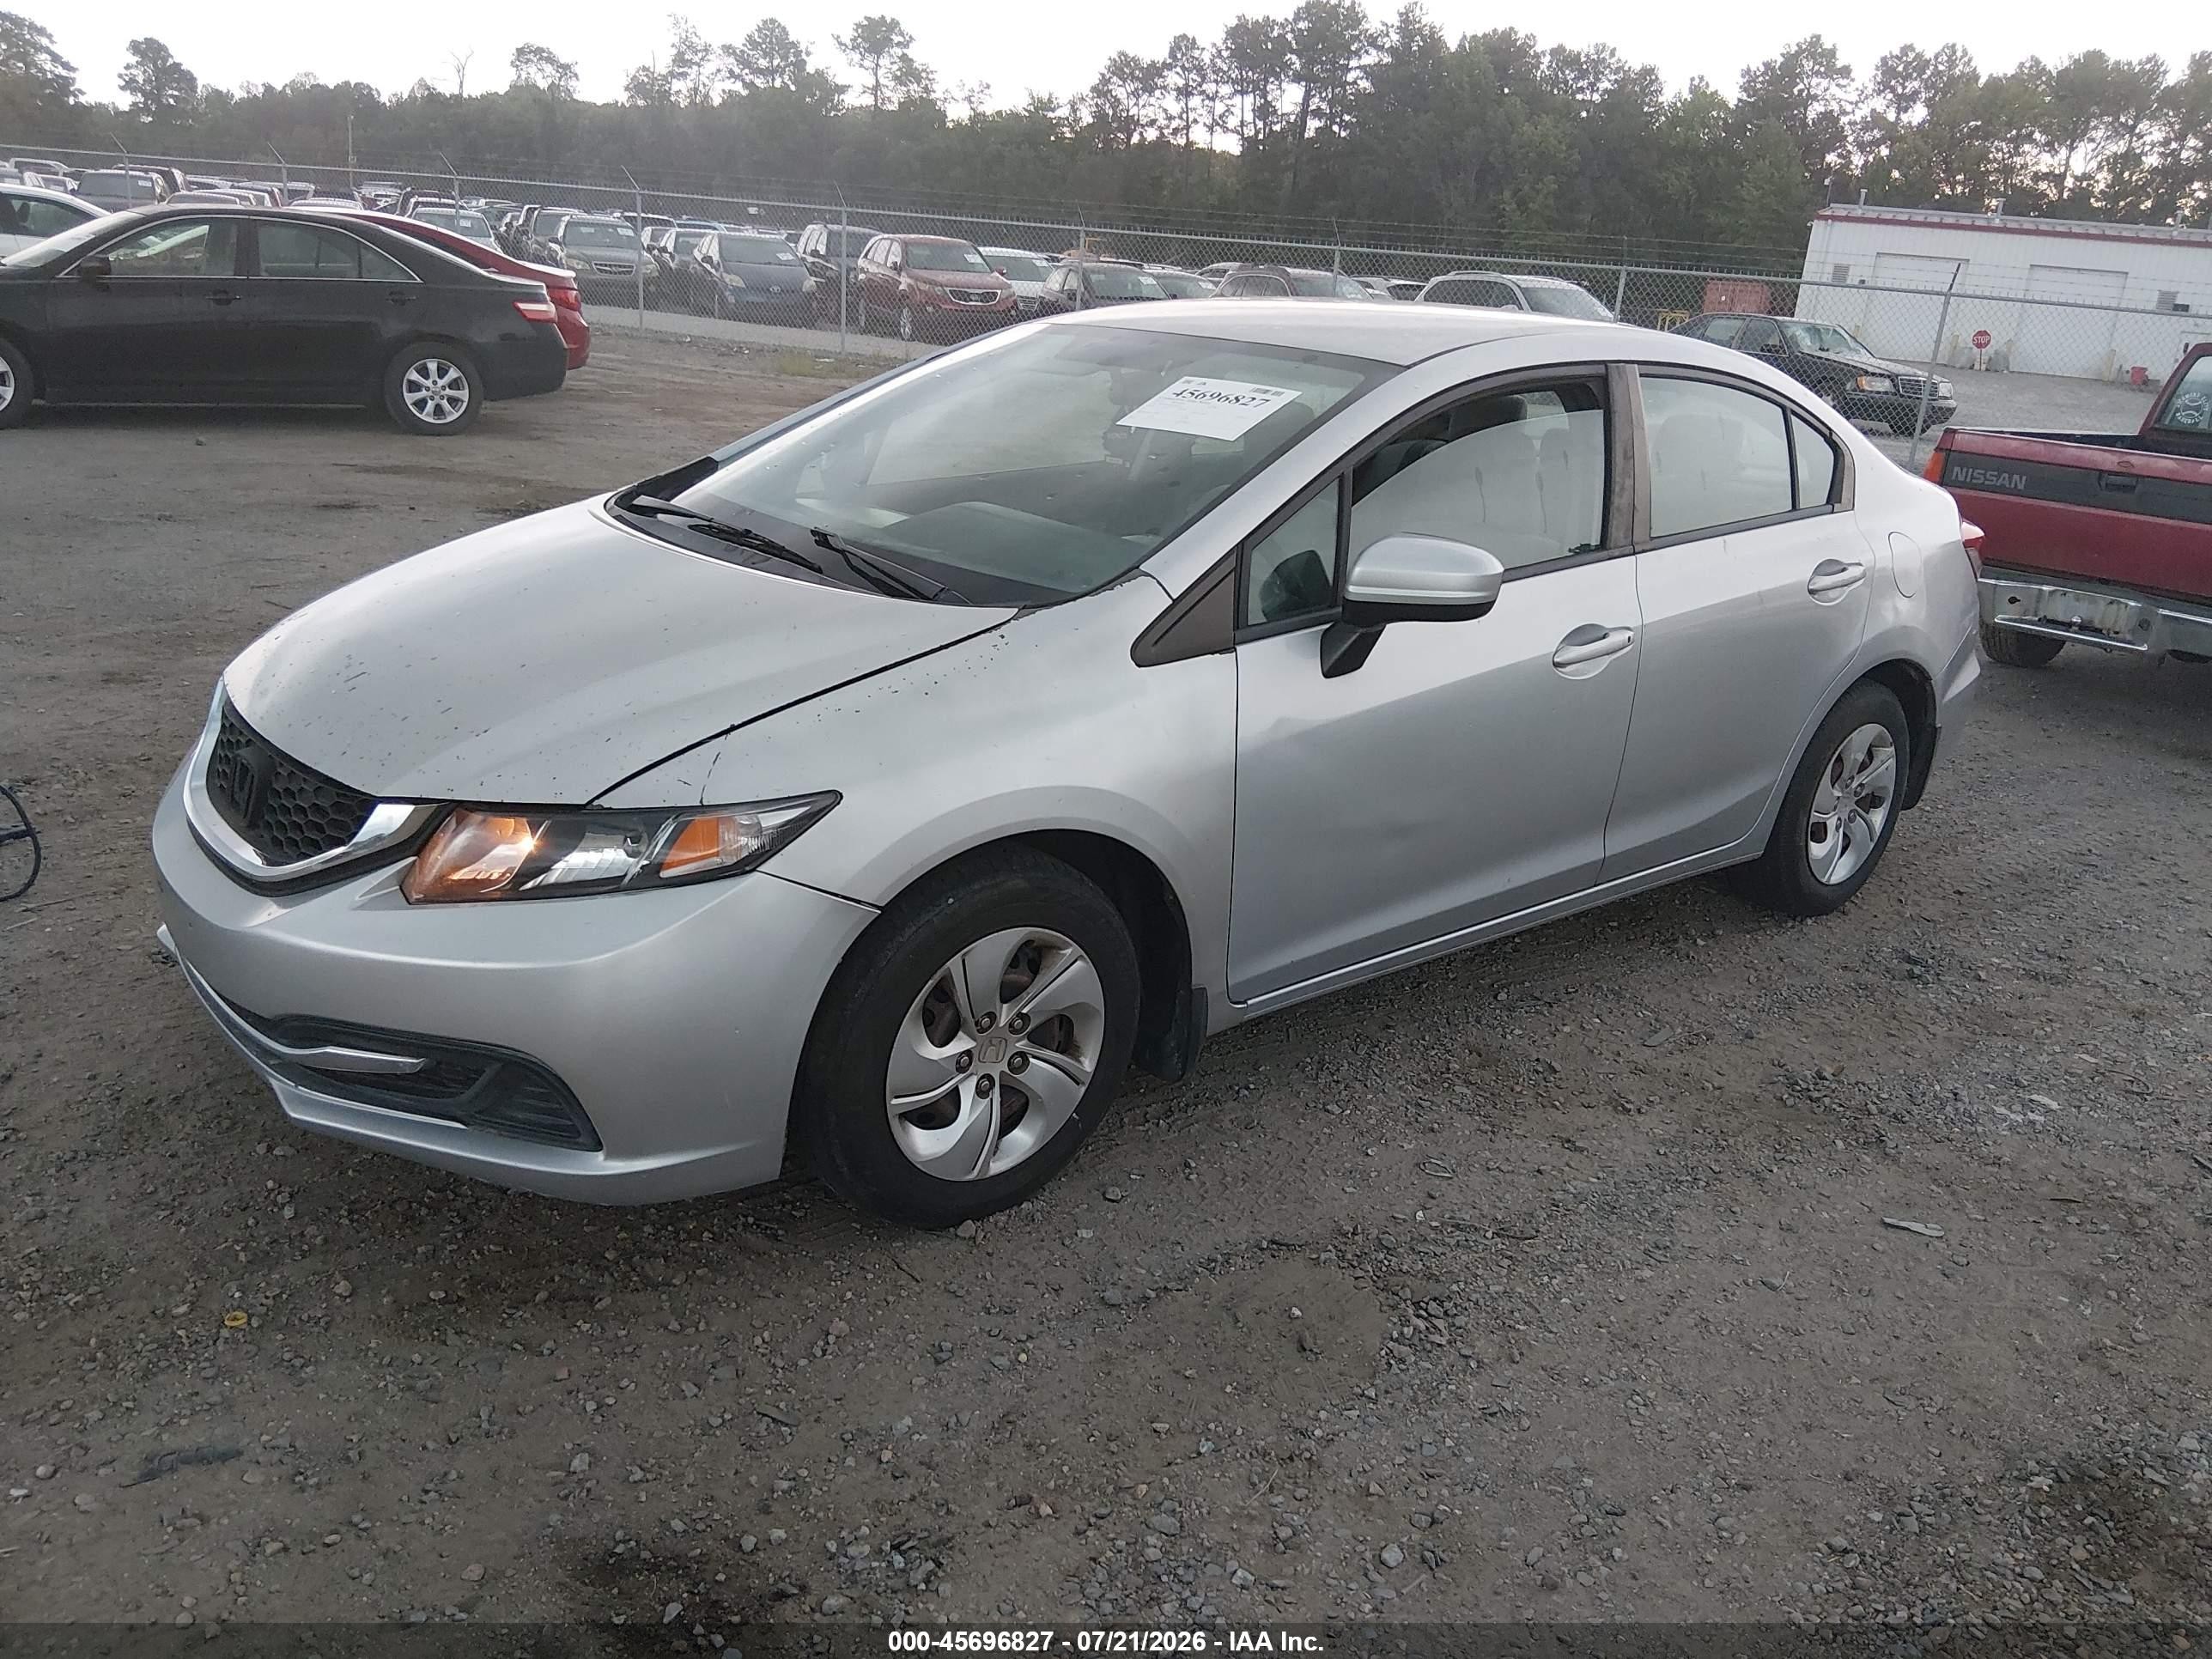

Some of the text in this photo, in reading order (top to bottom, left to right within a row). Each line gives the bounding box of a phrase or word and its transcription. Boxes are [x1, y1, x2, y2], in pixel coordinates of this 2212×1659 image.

[1972, 336, 1990, 344] STOP
[1172, 388, 1271, 408] 45696827
[1951, 466, 2027, 489] NISSAN
